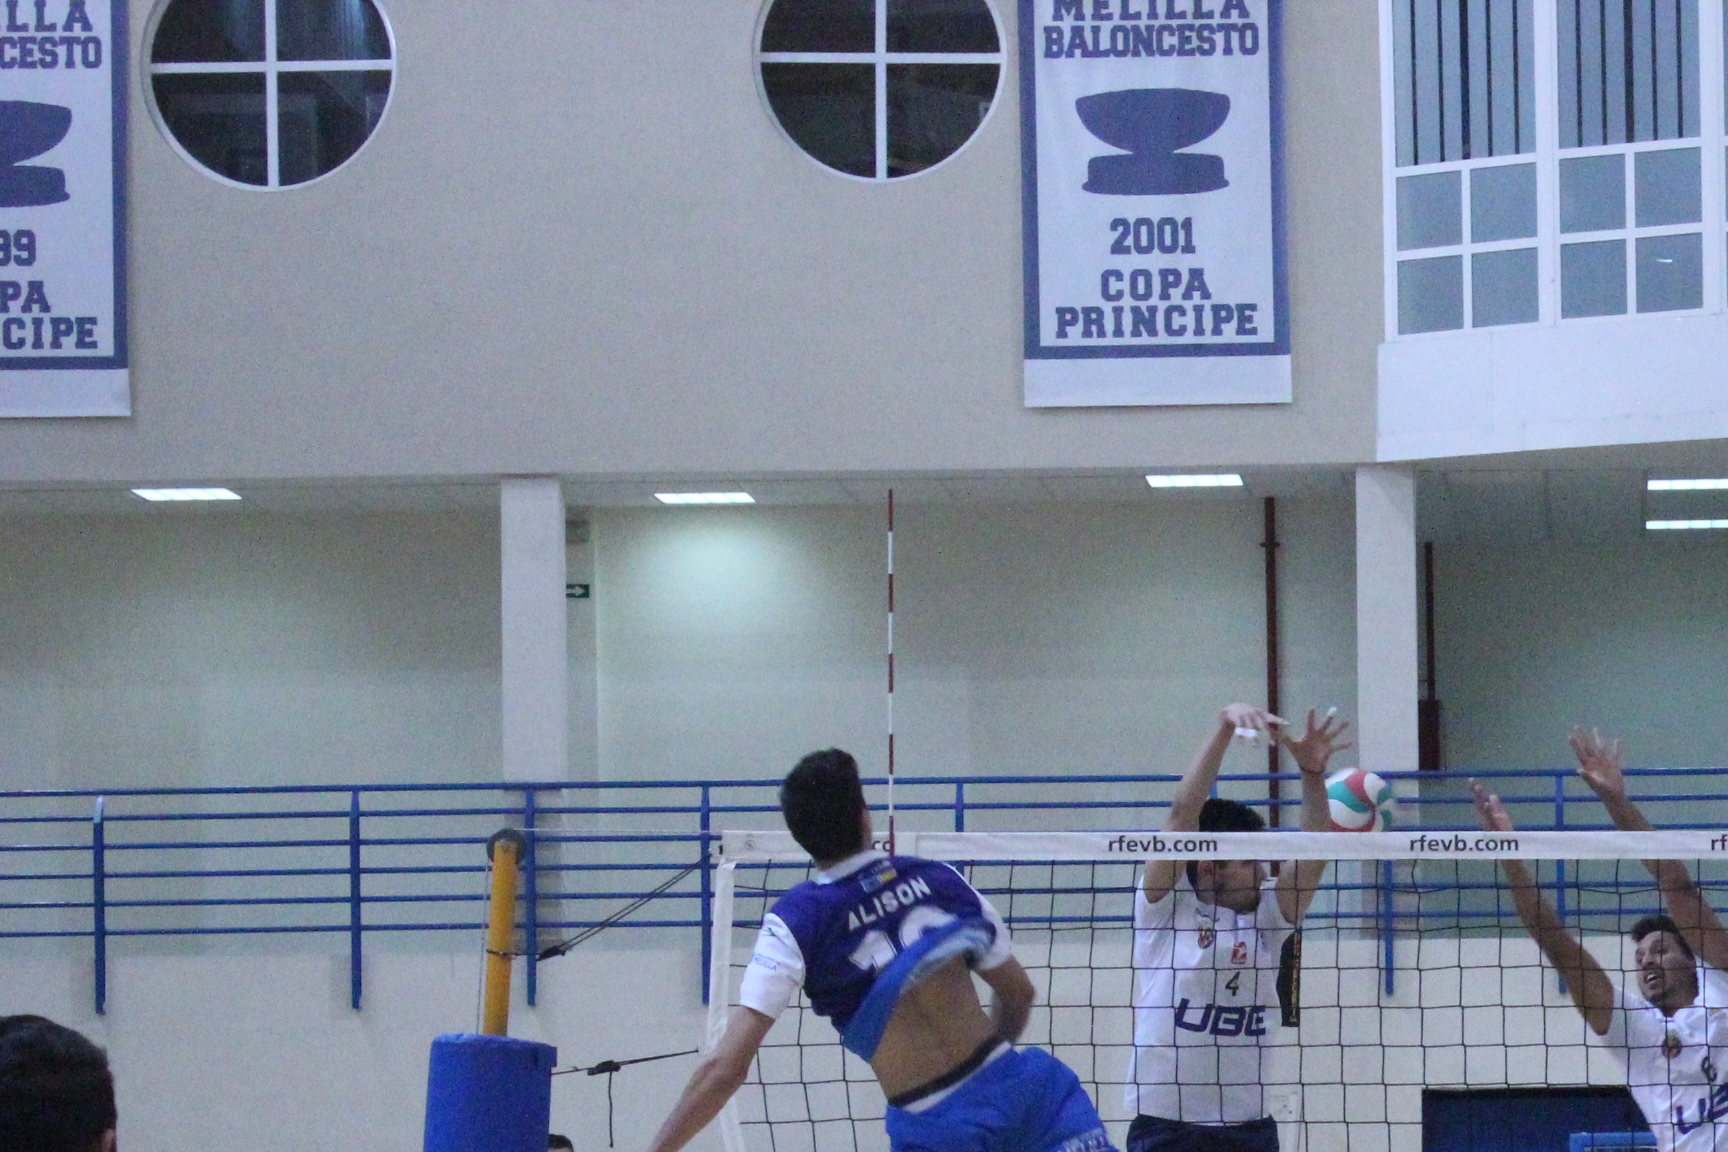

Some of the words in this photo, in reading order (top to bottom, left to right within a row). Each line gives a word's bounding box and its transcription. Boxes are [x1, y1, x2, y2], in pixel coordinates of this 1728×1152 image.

[1043, 22, 1259, 58] BALONCESTO
[1110, 217, 1196, 254] 2001
[1101, 268, 1212, 301] COPA
[1055, 303, 1258, 338] PRINCIPE
[1108, 835, 1218, 852] rfevb.com
[1409, 834, 1519, 852] rfevb.com
[848, 875, 932, 931] ALISON
[1225, 971, 1241, 997] 4
